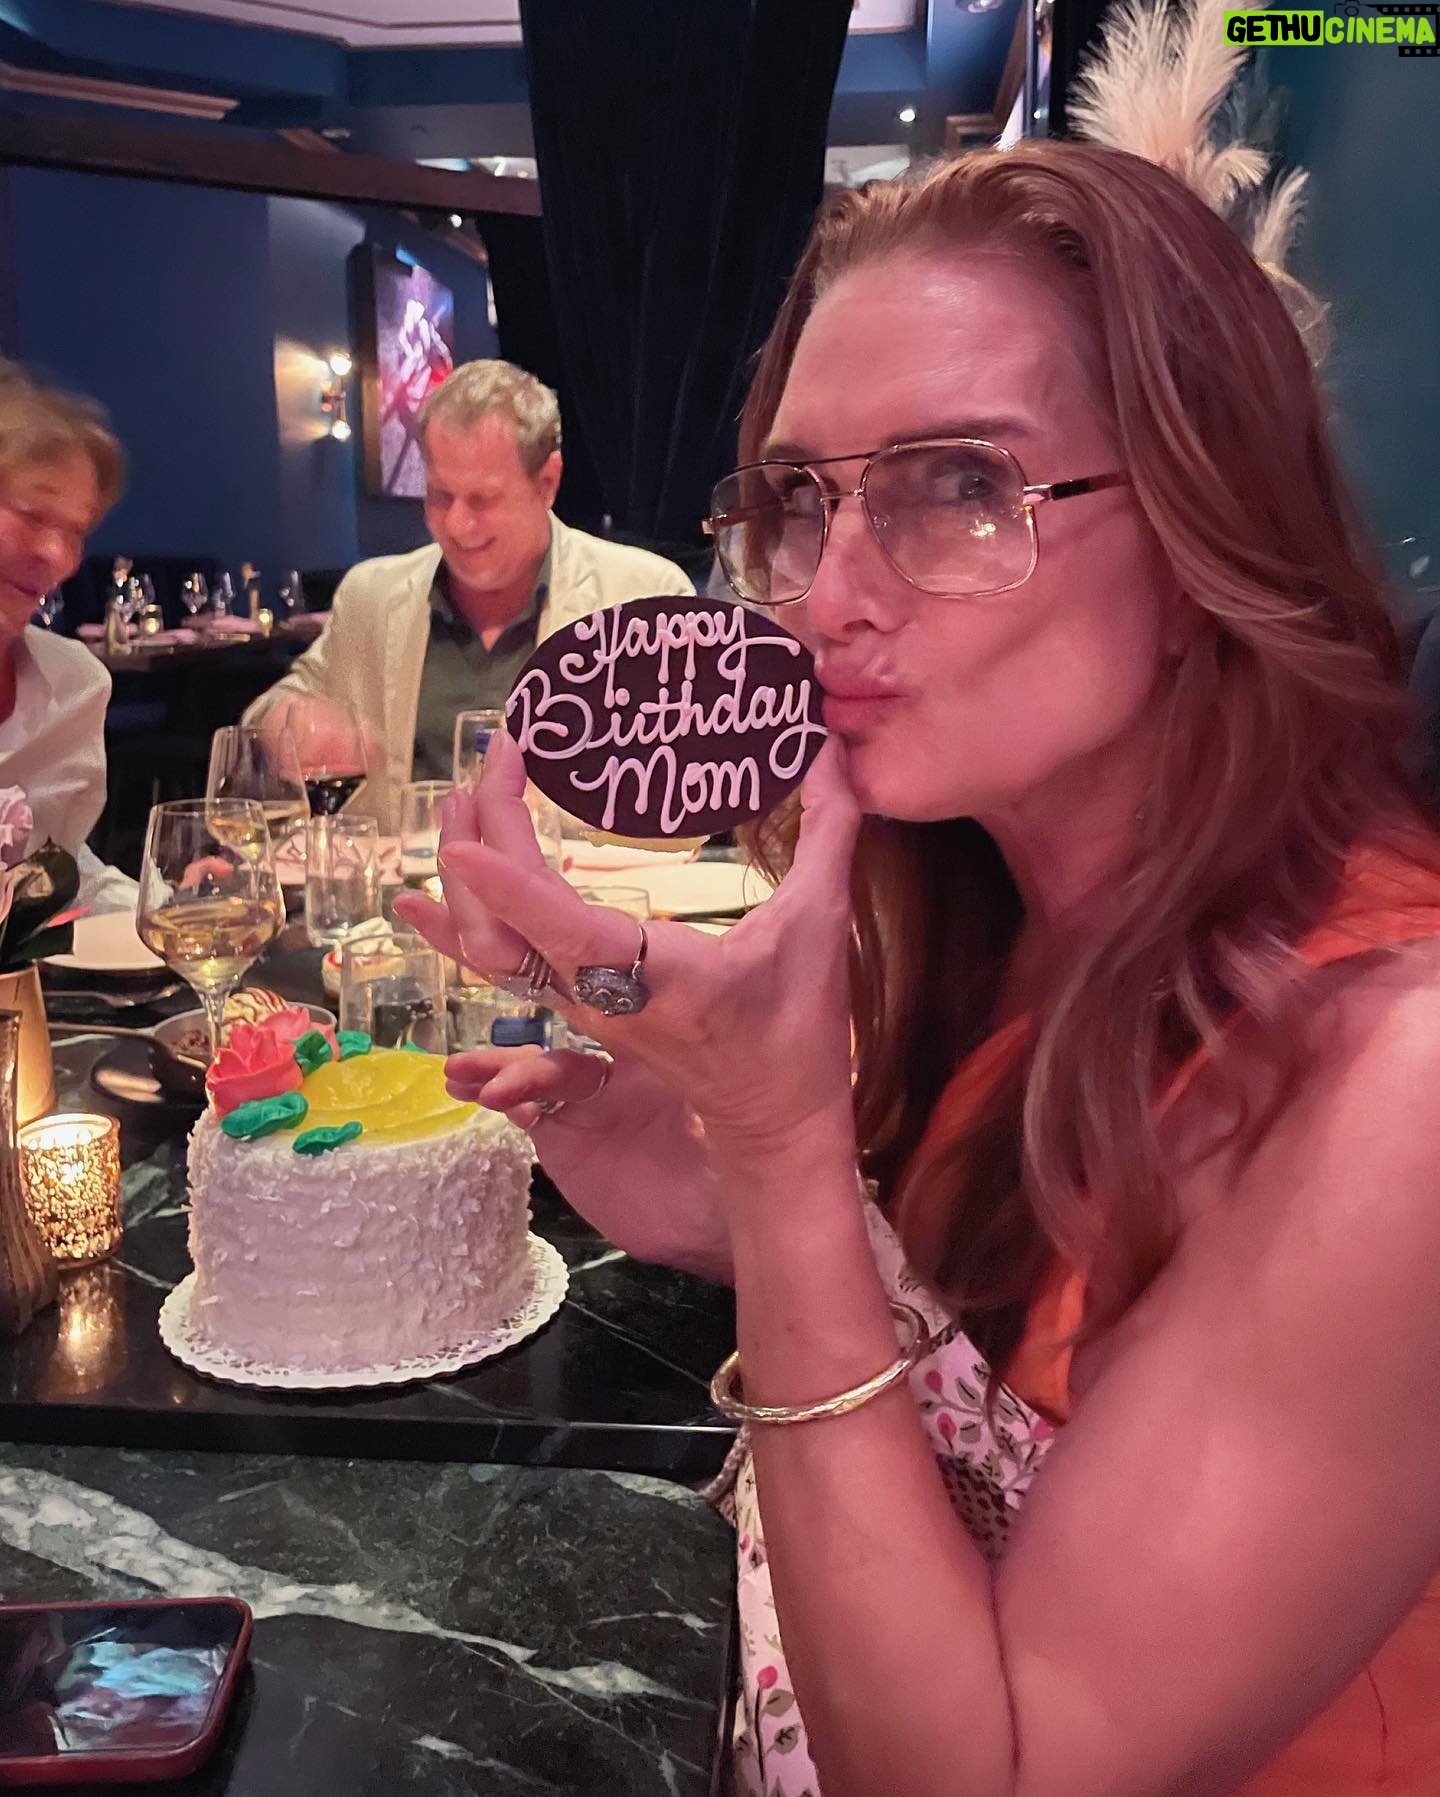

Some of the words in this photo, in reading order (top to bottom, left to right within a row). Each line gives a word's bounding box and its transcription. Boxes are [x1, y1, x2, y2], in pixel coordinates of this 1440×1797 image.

[559, 603, 801, 709] Happy
[504, 668, 829, 780] Birthday
[569, 745, 761, 834] Mom
